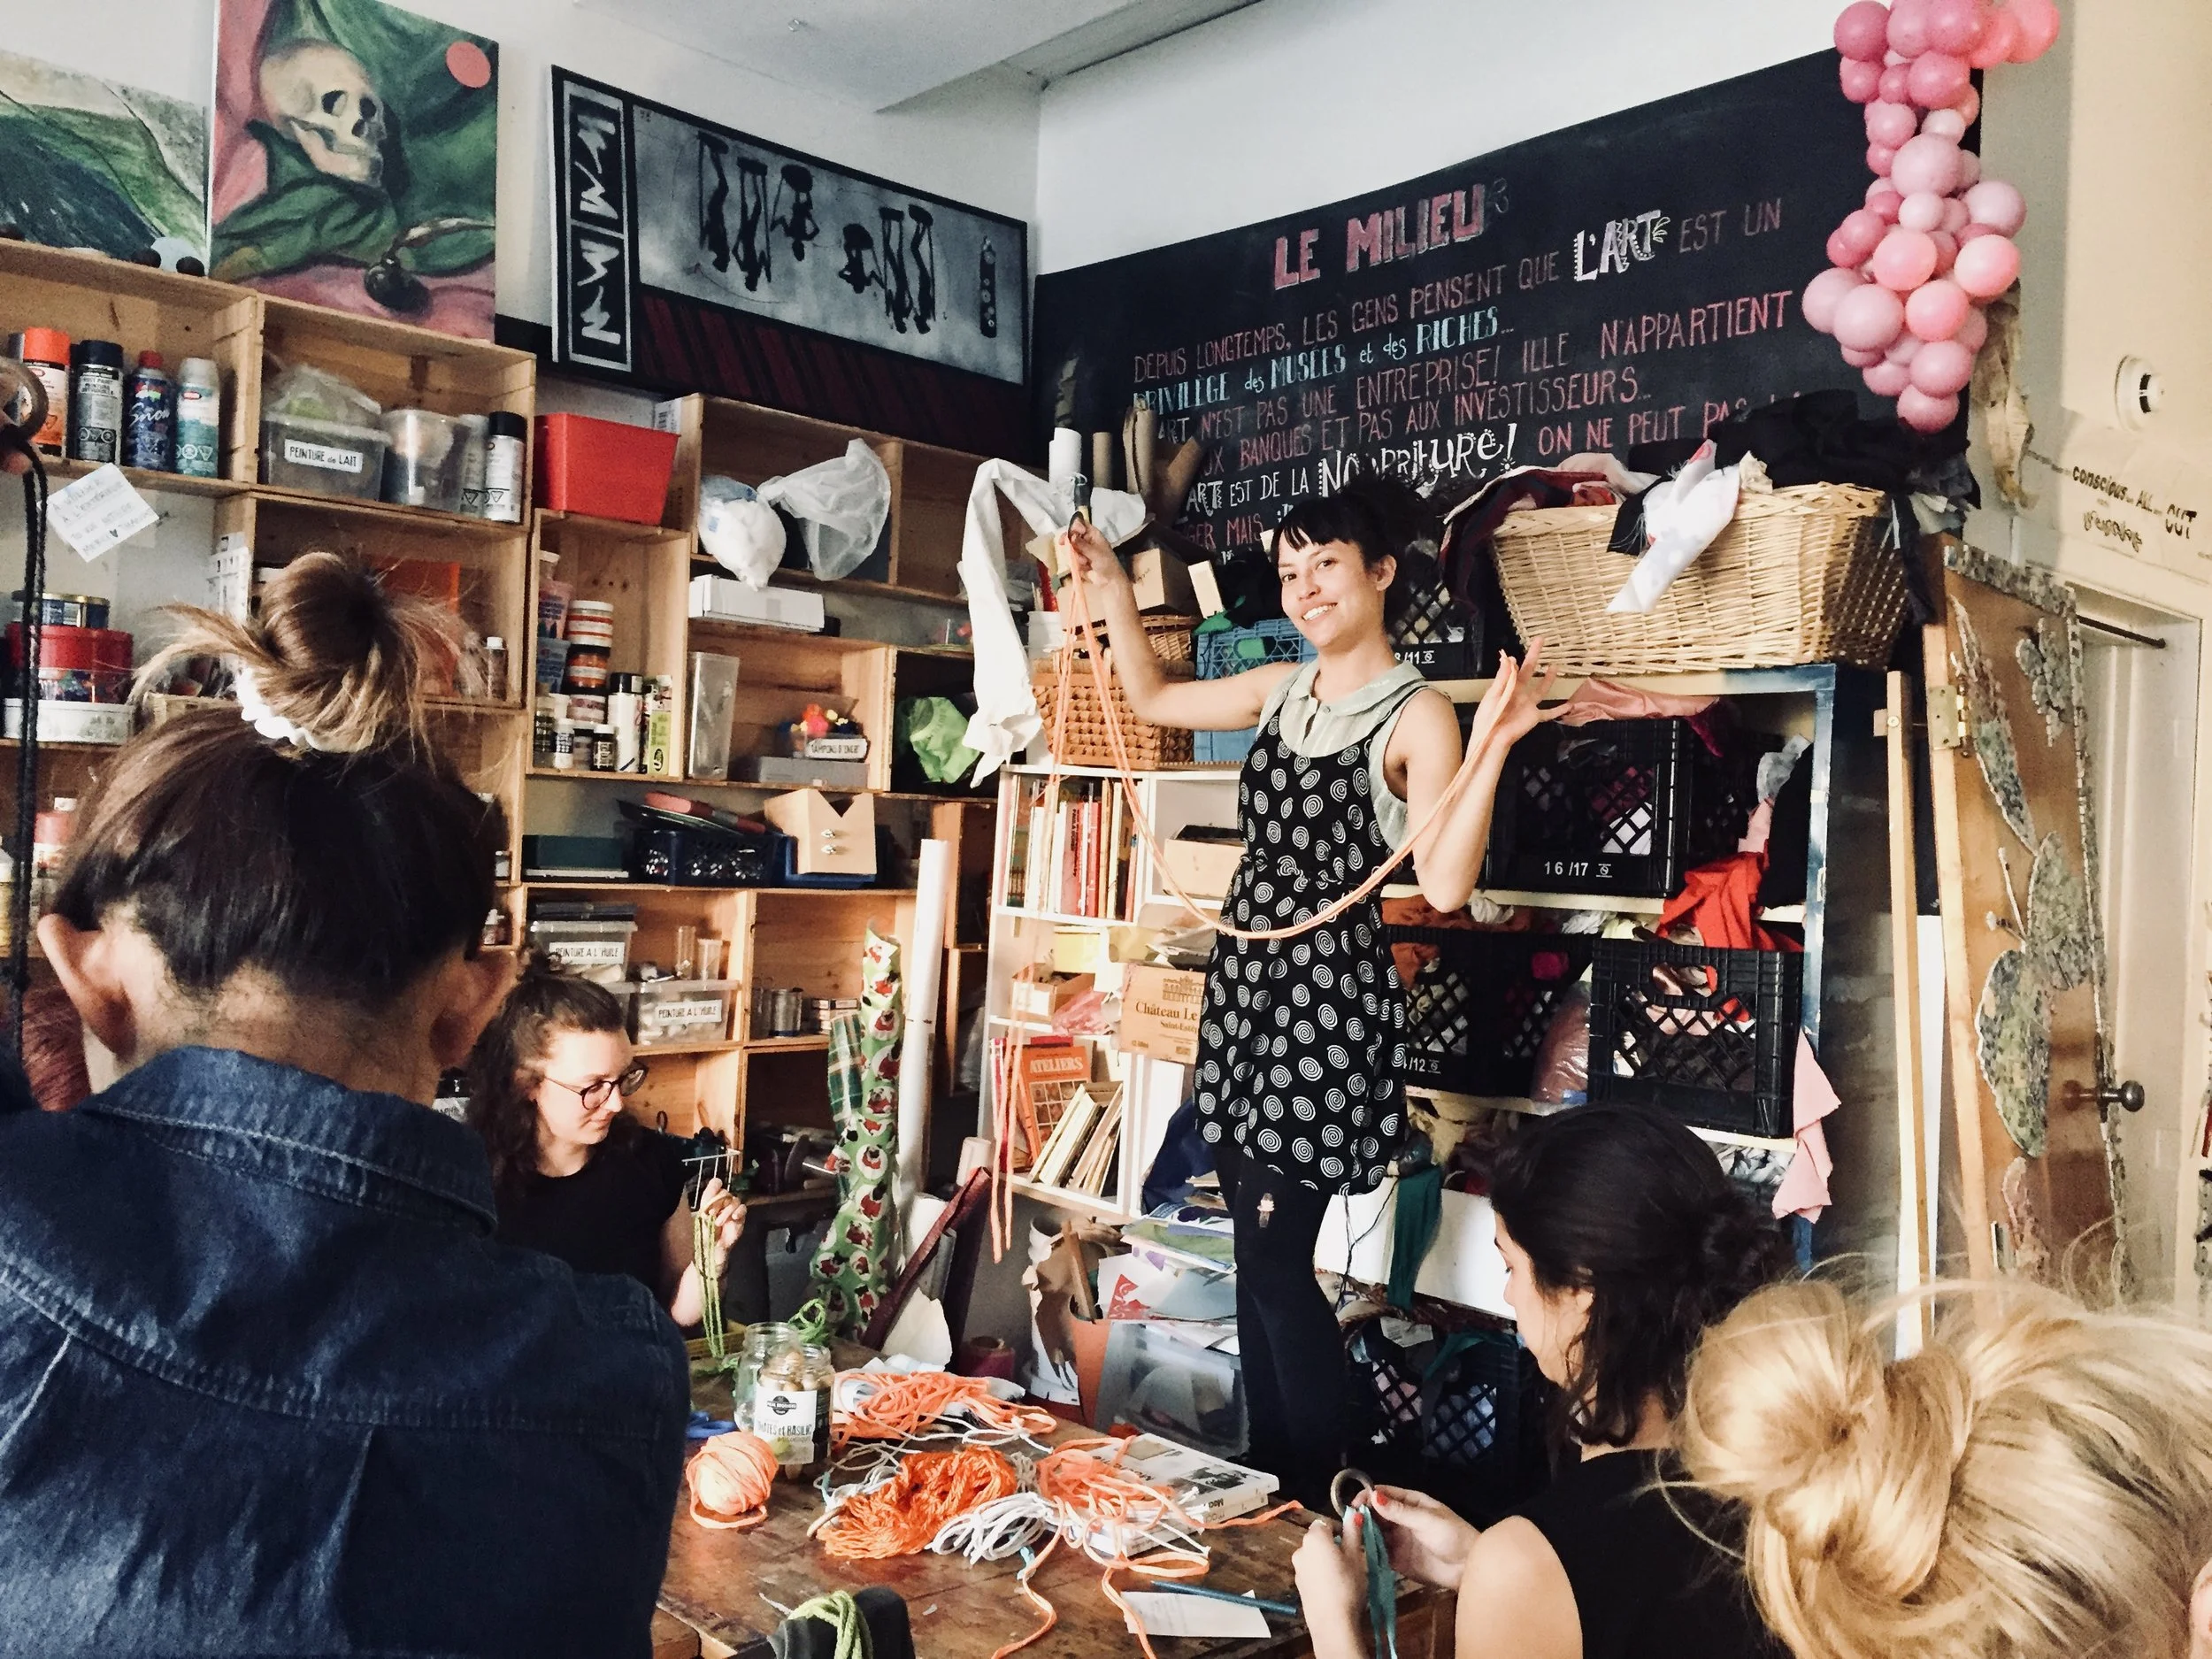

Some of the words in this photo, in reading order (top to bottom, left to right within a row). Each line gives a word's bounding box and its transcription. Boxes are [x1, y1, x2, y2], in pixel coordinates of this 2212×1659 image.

[1274, 228, 1321, 290] LE
[1346, 183, 1486, 273] MILIEU
[1133, 348, 1187, 383] DEPUIS
[1197, 323, 1292, 370] LONGTEMPS,
[1303, 310, 1339, 346] LES
[1351, 295, 1399, 334] GENS
[1409, 265, 1507, 320] PENSENT
[1518, 250, 1560, 291] QUE
[1573, 210, 1669, 281] L'ART
[1678, 210, 1727, 255] EST
[1744, 197, 1782, 238] UN
[1200, 404, 1246, 442] N'EST
[1256, 396, 1288, 430] PAS
[1302, 384, 1338, 419] UNE
[1356, 344, 1502, 411] ENTREPRISE!
[1244, 367, 1265, 394] des
[1271, 343, 1347, 390] MUSÉES
[1359, 342, 1374, 365] et
[1383, 333, 1408, 361] des
[289, 445, 325, 462] PEINTURE
[339, 454, 357, 467] LAIT
[1204, 446, 1225, 477] UX
[1239, 423, 1312, 472] BANQUES
[1321, 415, 1350, 452] ET
[1358, 408, 1393, 443] PAS
[1405, 400, 1441, 435] AUX
[1230, 480, 1253, 507] EST
[1260, 471, 1281, 501] DE
[1291, 467, 1310, 496] LA
[1539, 422, 1572, 457] ON
[1586, 418, 1613, 450] NE
[1628, 405, 1686, 445] PEUT
[2072, 465, 2128, 501] conscious
[1226, 513, 1263, 547] MAIS
[1135, 1001, 1180, 1018] Château
[1030, 1056, 1084, 1074] ATELIERS
